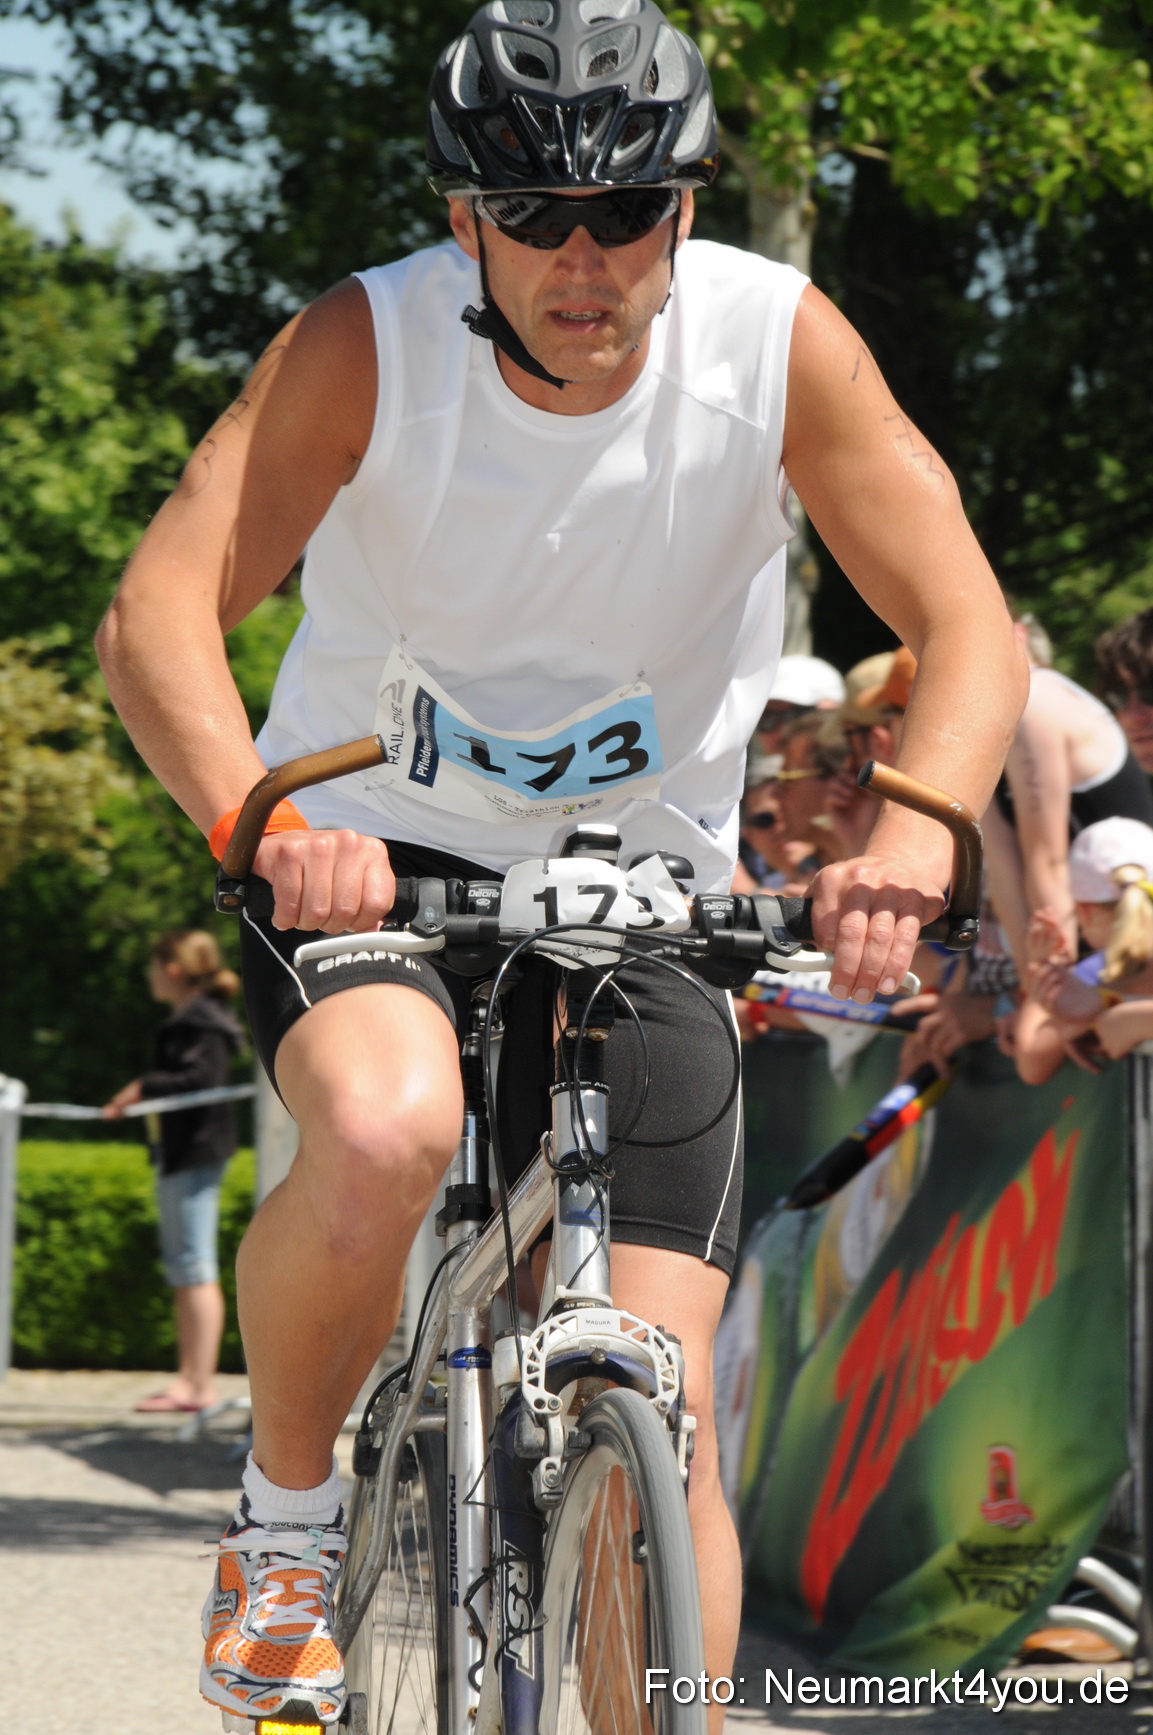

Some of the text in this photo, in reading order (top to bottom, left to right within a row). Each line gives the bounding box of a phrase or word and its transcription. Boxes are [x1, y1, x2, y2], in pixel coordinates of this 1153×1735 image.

[453, 720, 649, 793] 173
[467, 889, 500, 898] Deore
[702, 903, 734, 911] Deore
[448, 1473, 460, 1608] DYNAMICS
[503, 1540, 535, 1680] RST
